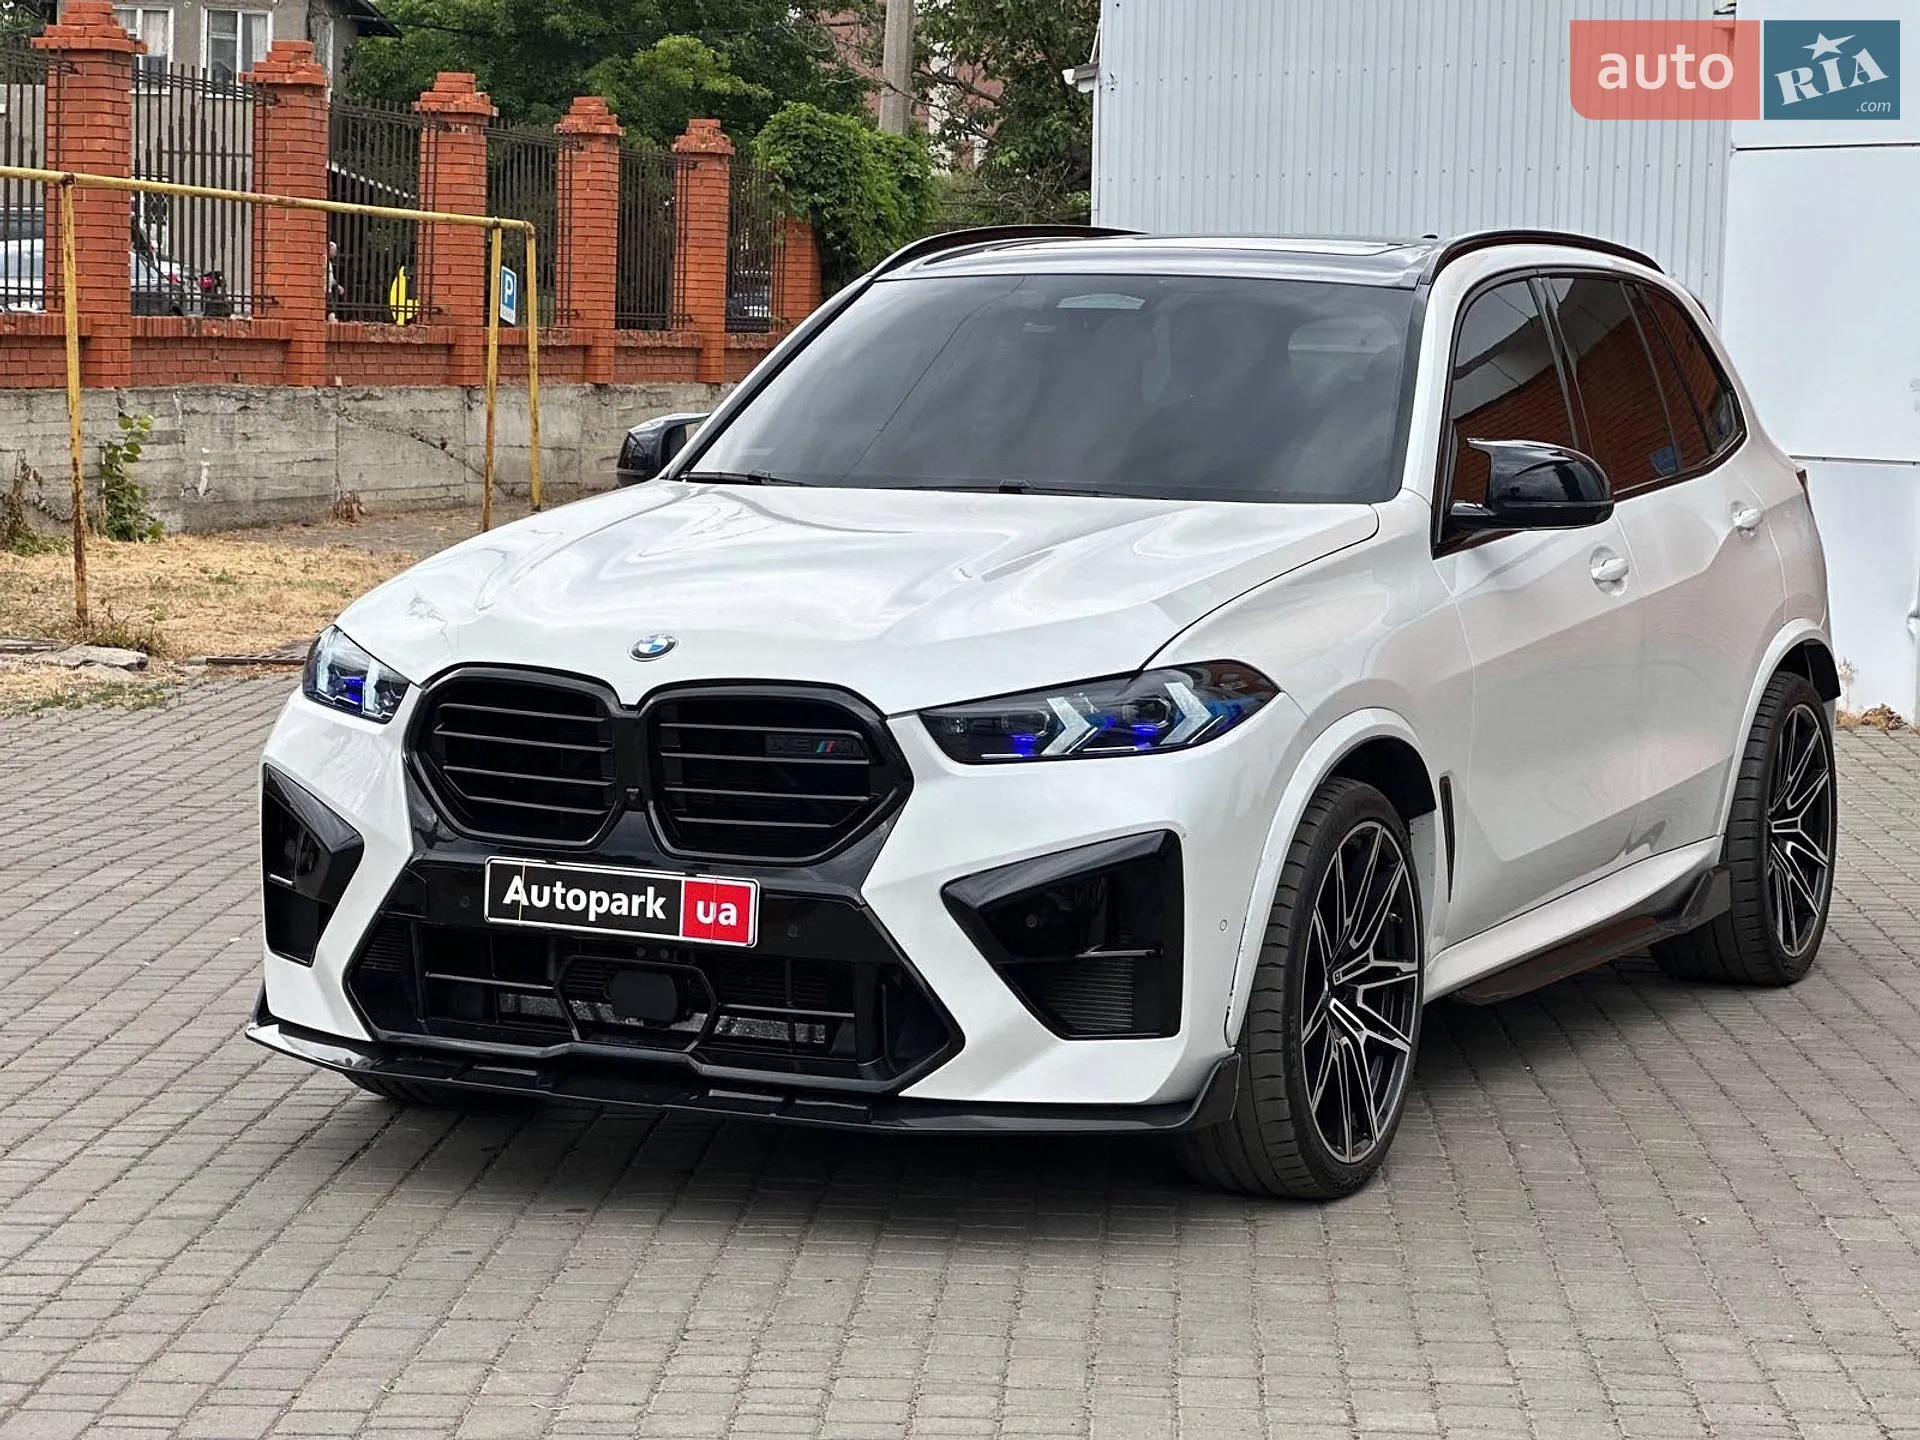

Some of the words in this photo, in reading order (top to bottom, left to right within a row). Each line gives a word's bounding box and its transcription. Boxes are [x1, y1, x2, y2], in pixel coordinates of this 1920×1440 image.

[504, 273, 514, 304] P
[502, 875, 666, 921] Autopark
[696, 900, 737, 926] ua
